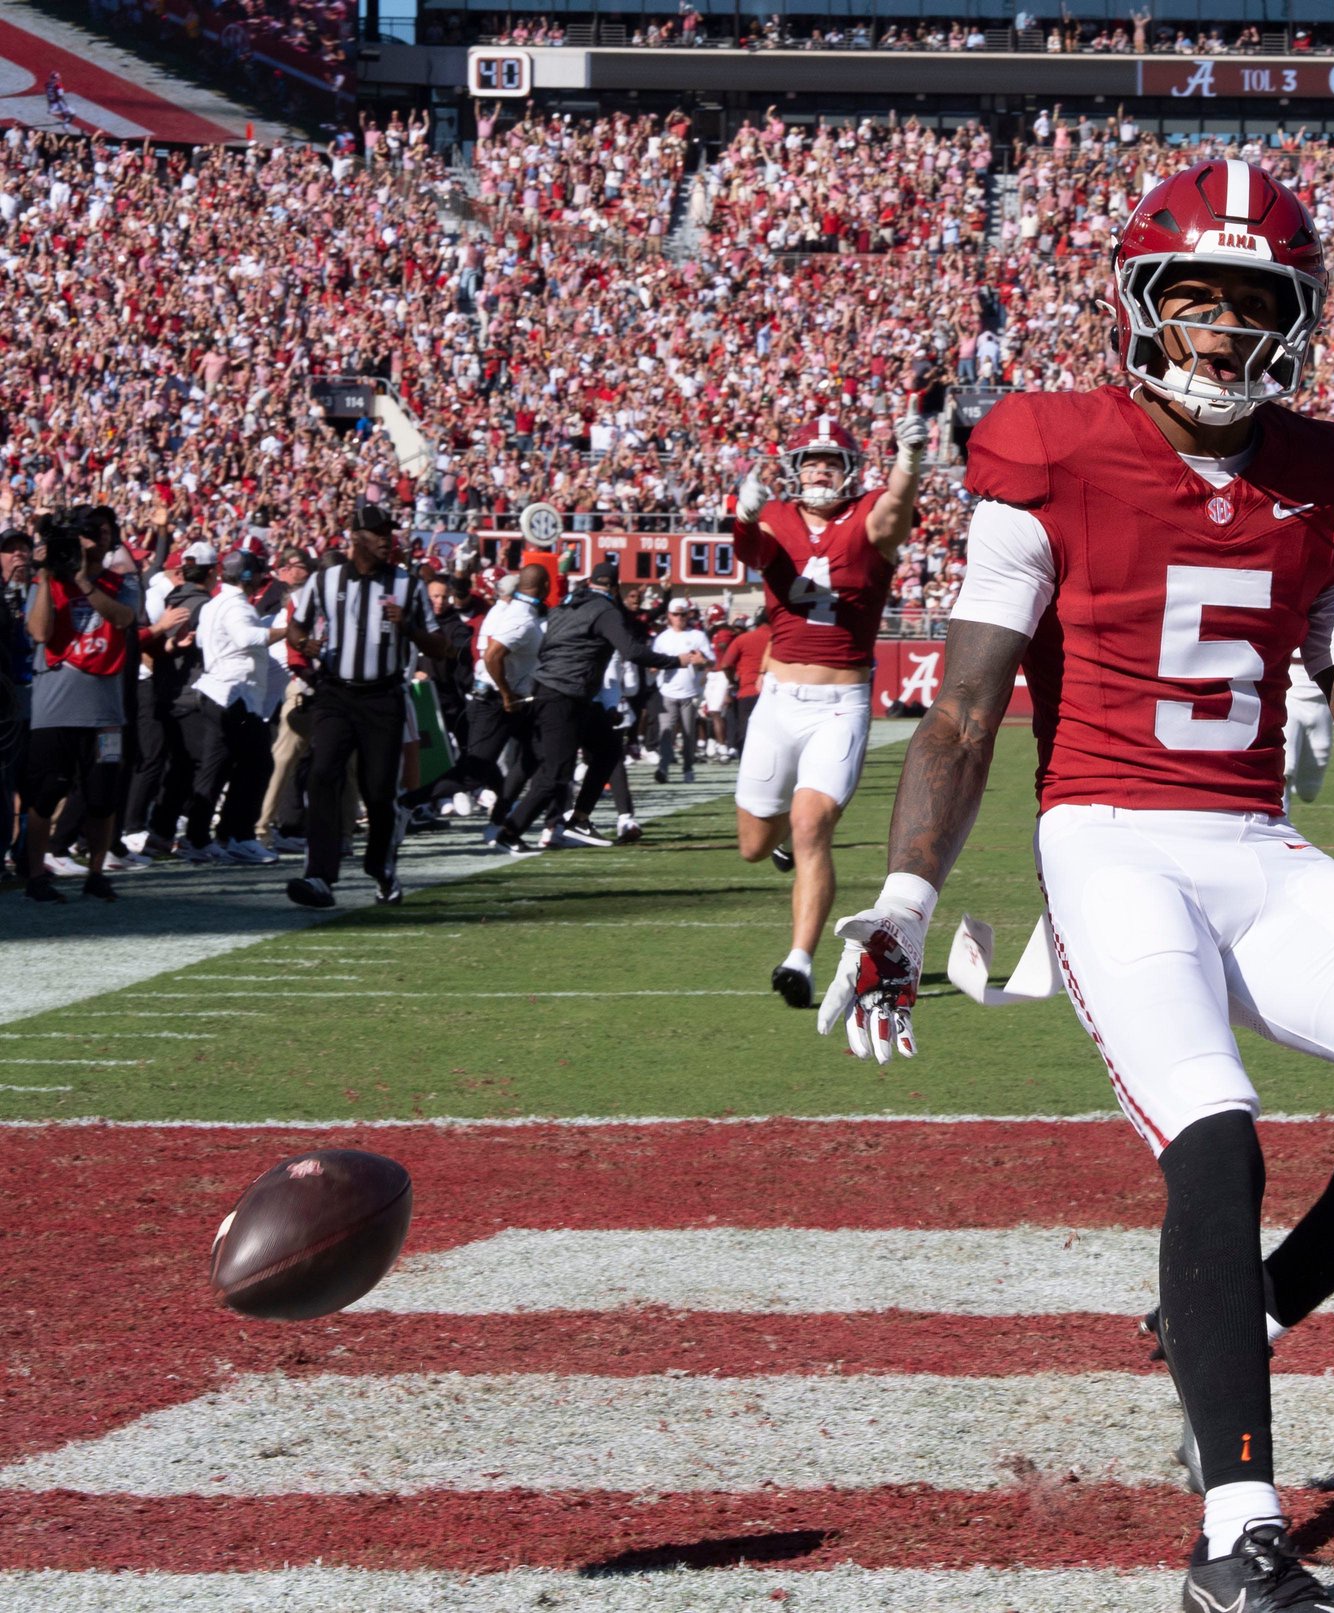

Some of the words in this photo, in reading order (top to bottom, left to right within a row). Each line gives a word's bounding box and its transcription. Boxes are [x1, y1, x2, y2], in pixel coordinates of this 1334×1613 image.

[479, 60, 520, 89] 40
[1240, 69, 1276, 93] TOL
[1281, 69, 1298, 92] 3
[1217, 232, 1257, 251] BAMA
[690, 543, 733, 574] 40
[788, 555, 840, 627] 4
[1154, 564, 1273, 751] 5
